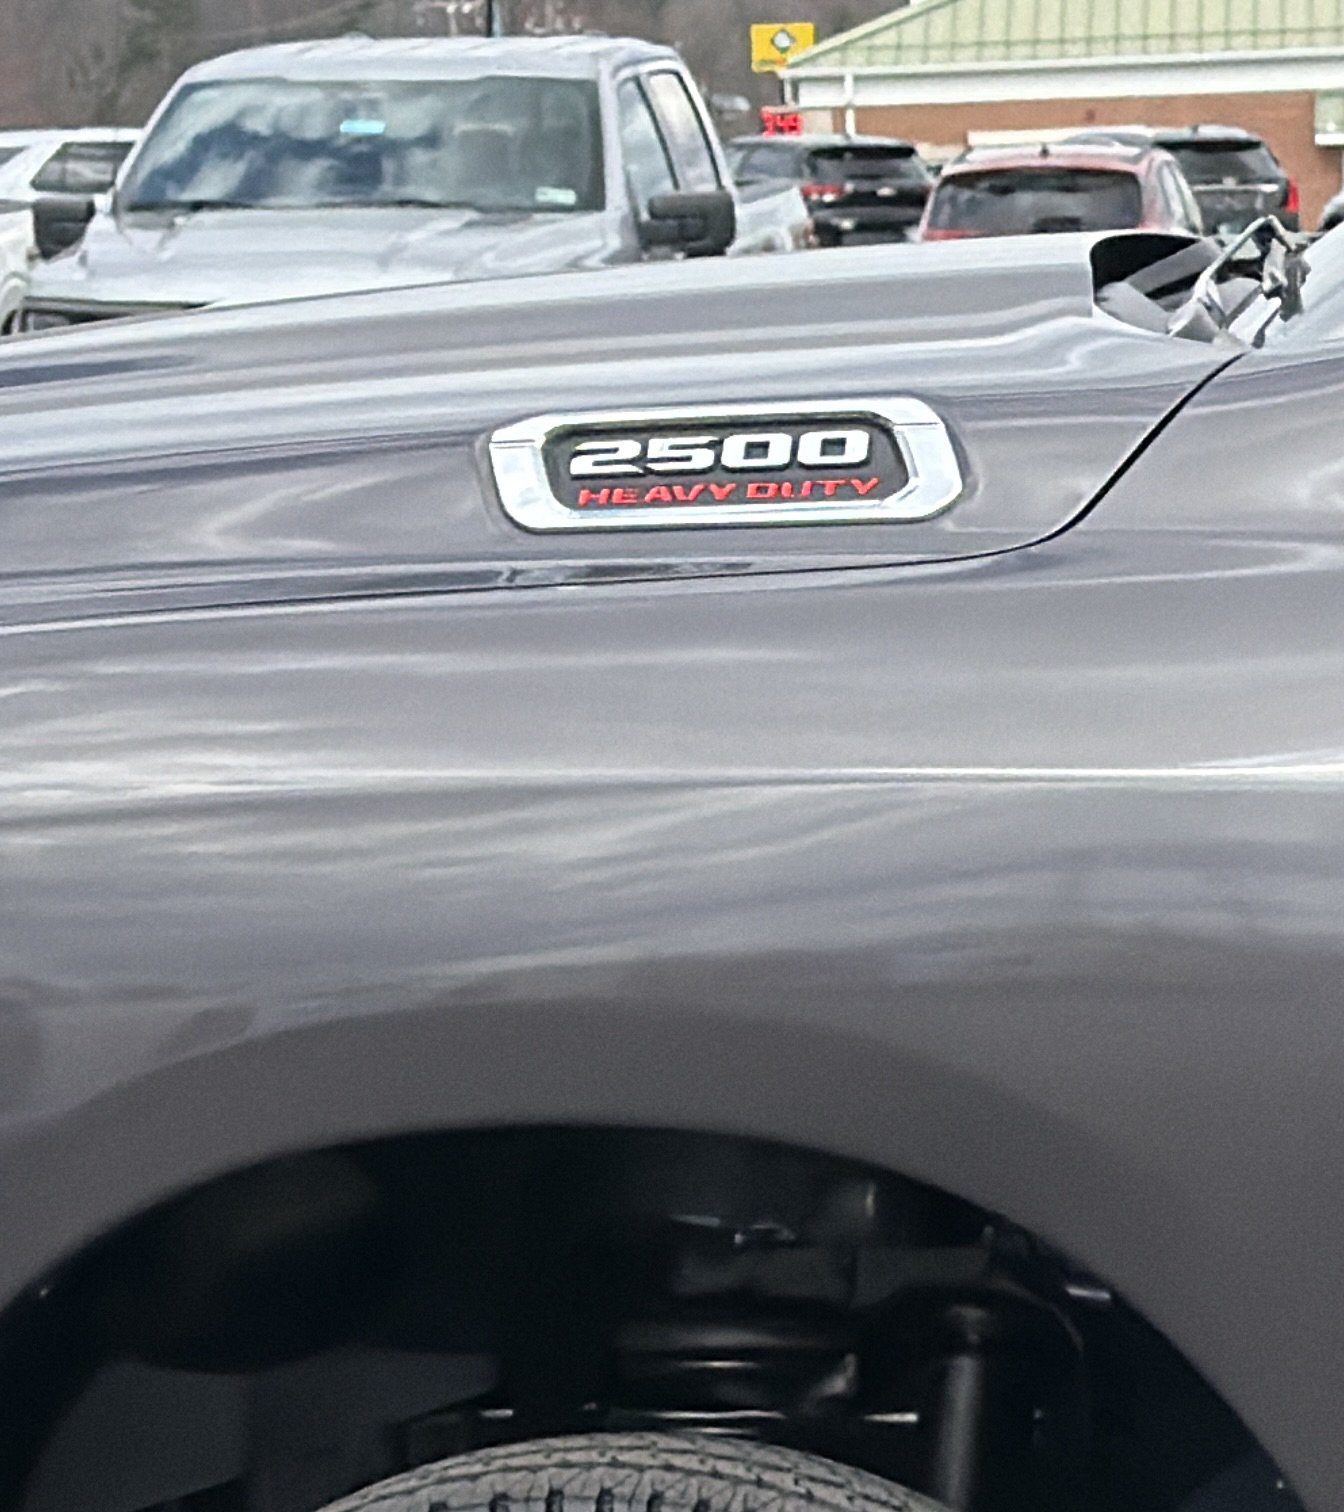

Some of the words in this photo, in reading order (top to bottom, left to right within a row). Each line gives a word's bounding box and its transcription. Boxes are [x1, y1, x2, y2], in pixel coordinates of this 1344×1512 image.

[568, 428, 872, 477] 2500
[577, 482, 737, 508] HEAVY
[745, 476, 881, 500] DUTY
